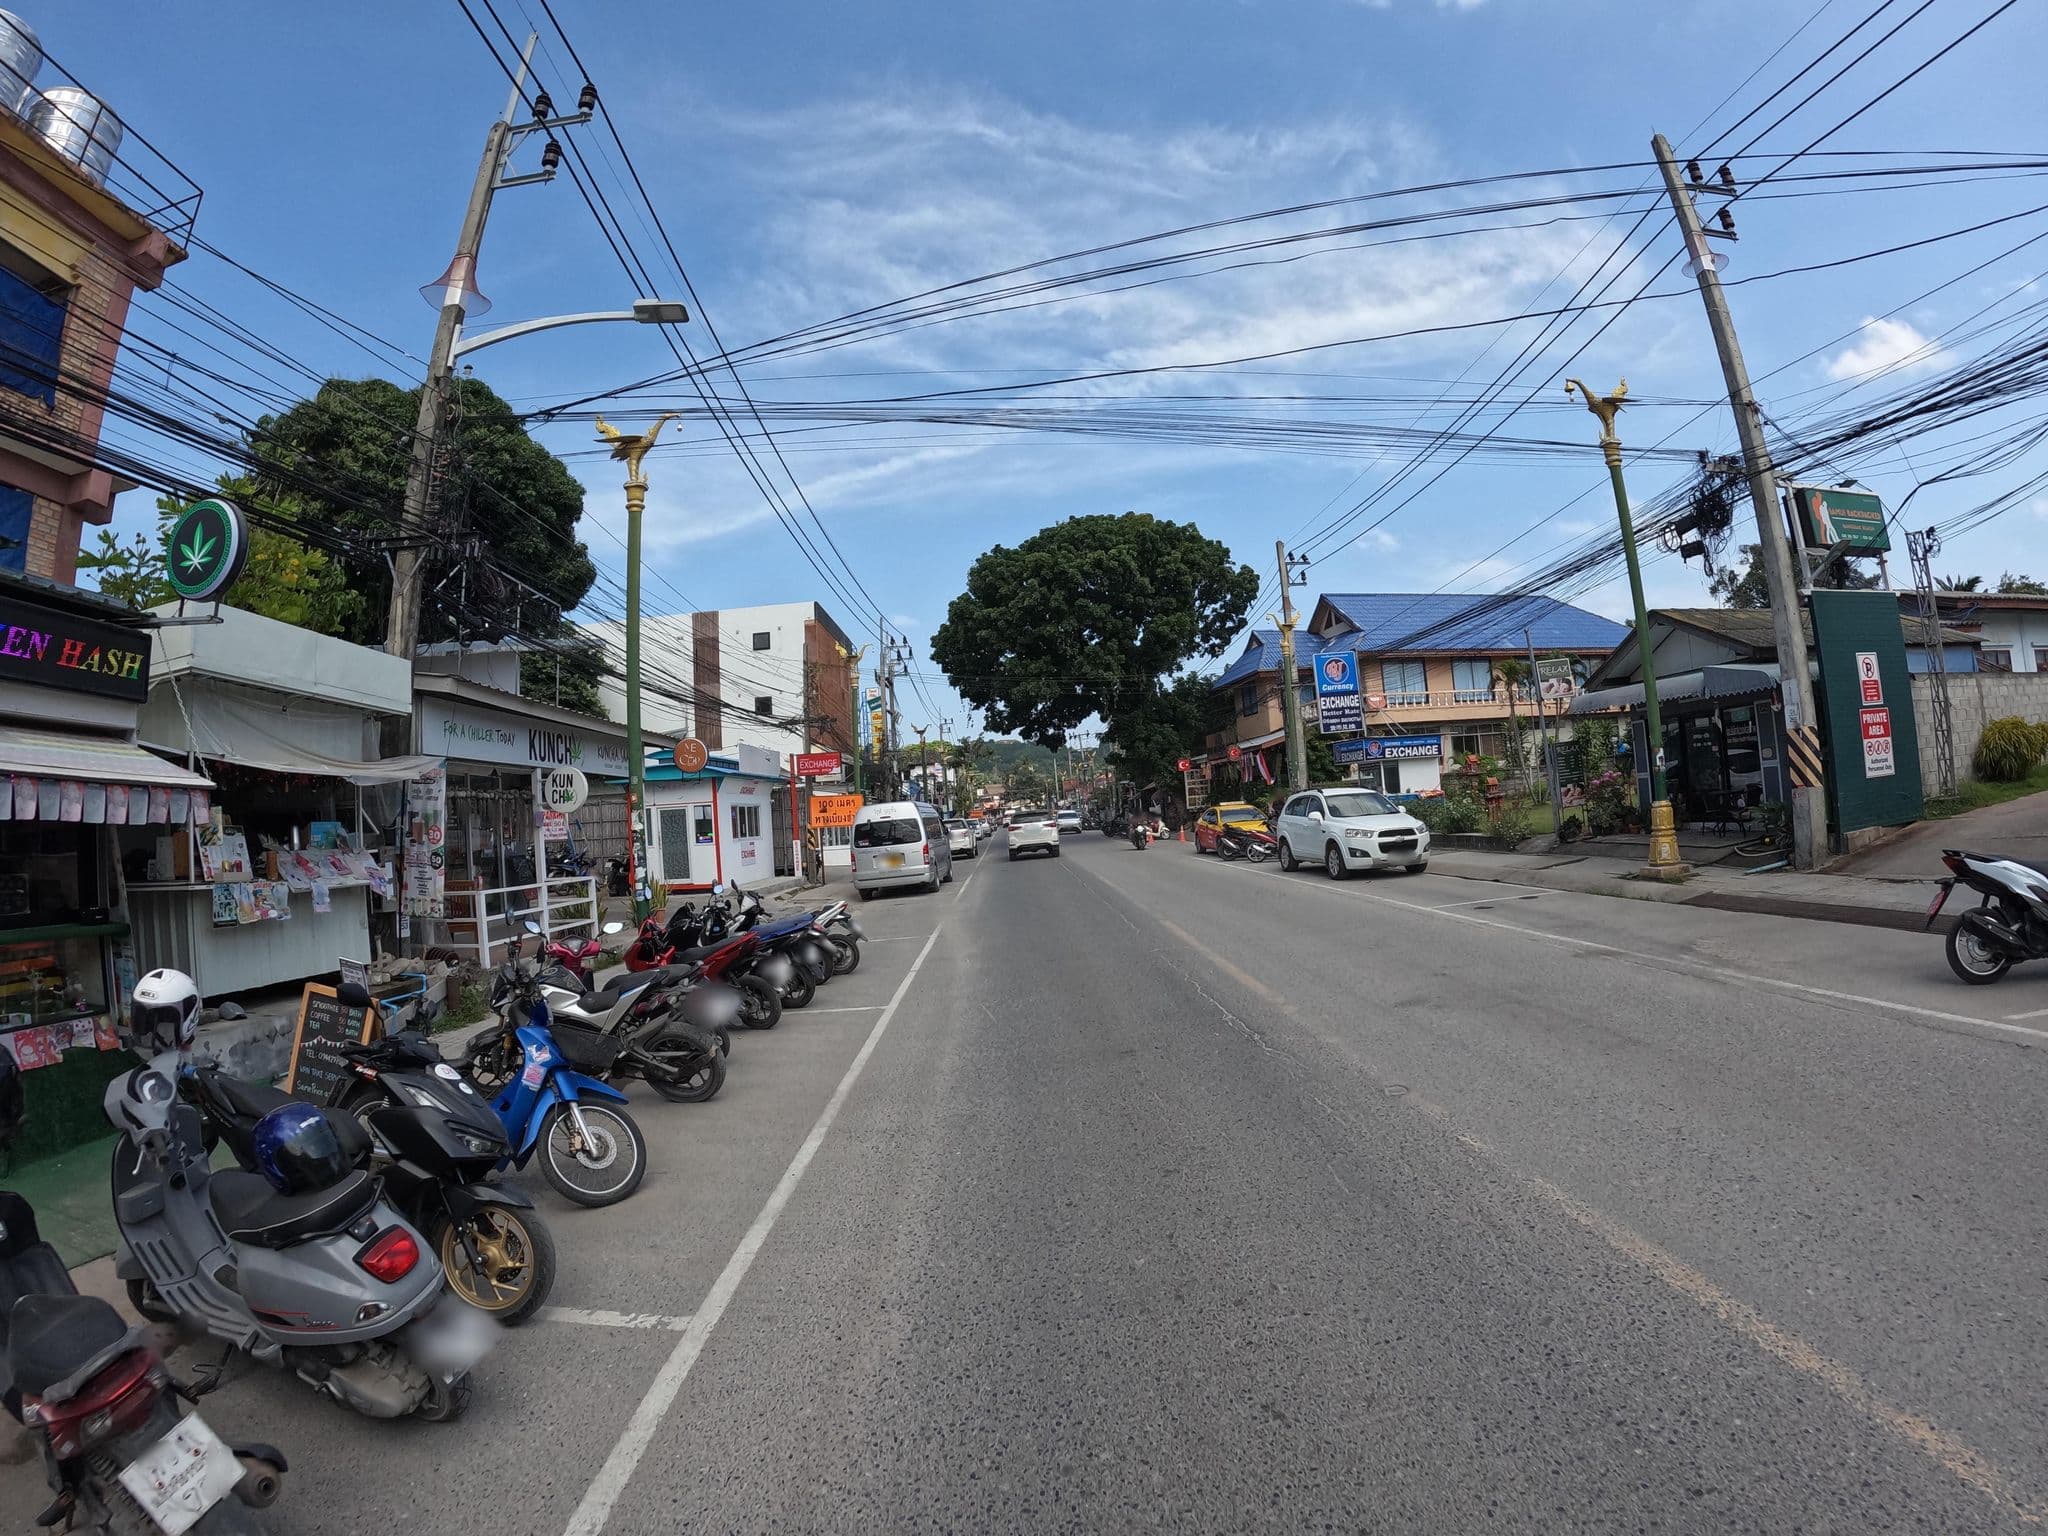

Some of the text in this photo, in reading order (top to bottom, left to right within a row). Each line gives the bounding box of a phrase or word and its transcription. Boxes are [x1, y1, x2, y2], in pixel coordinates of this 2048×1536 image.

[56, 638, 145, 680] HASH
[1540, 664, 1569, 675] RELAX
[1322, 683, 1354, 691] Currency
[1320, 694, 1360, 709] EXCHANGE
[1863, 712, 1888, 724] PRIVATE
[1868, 725, 1885, 736] AREA
[1384, 745, 1439, 758] EXCHANGE
[800, 758, 838, 769] EXCHANGE
[551, 773, 574, 789] KUN
[818, 800, 834, 809] 100
[428, 829, 441, 840] 30
[431, 854, 442, 864] 50
[310, 1011, 331, 1023] COFFEE
[309, 1020, 320, 1031] TEA
